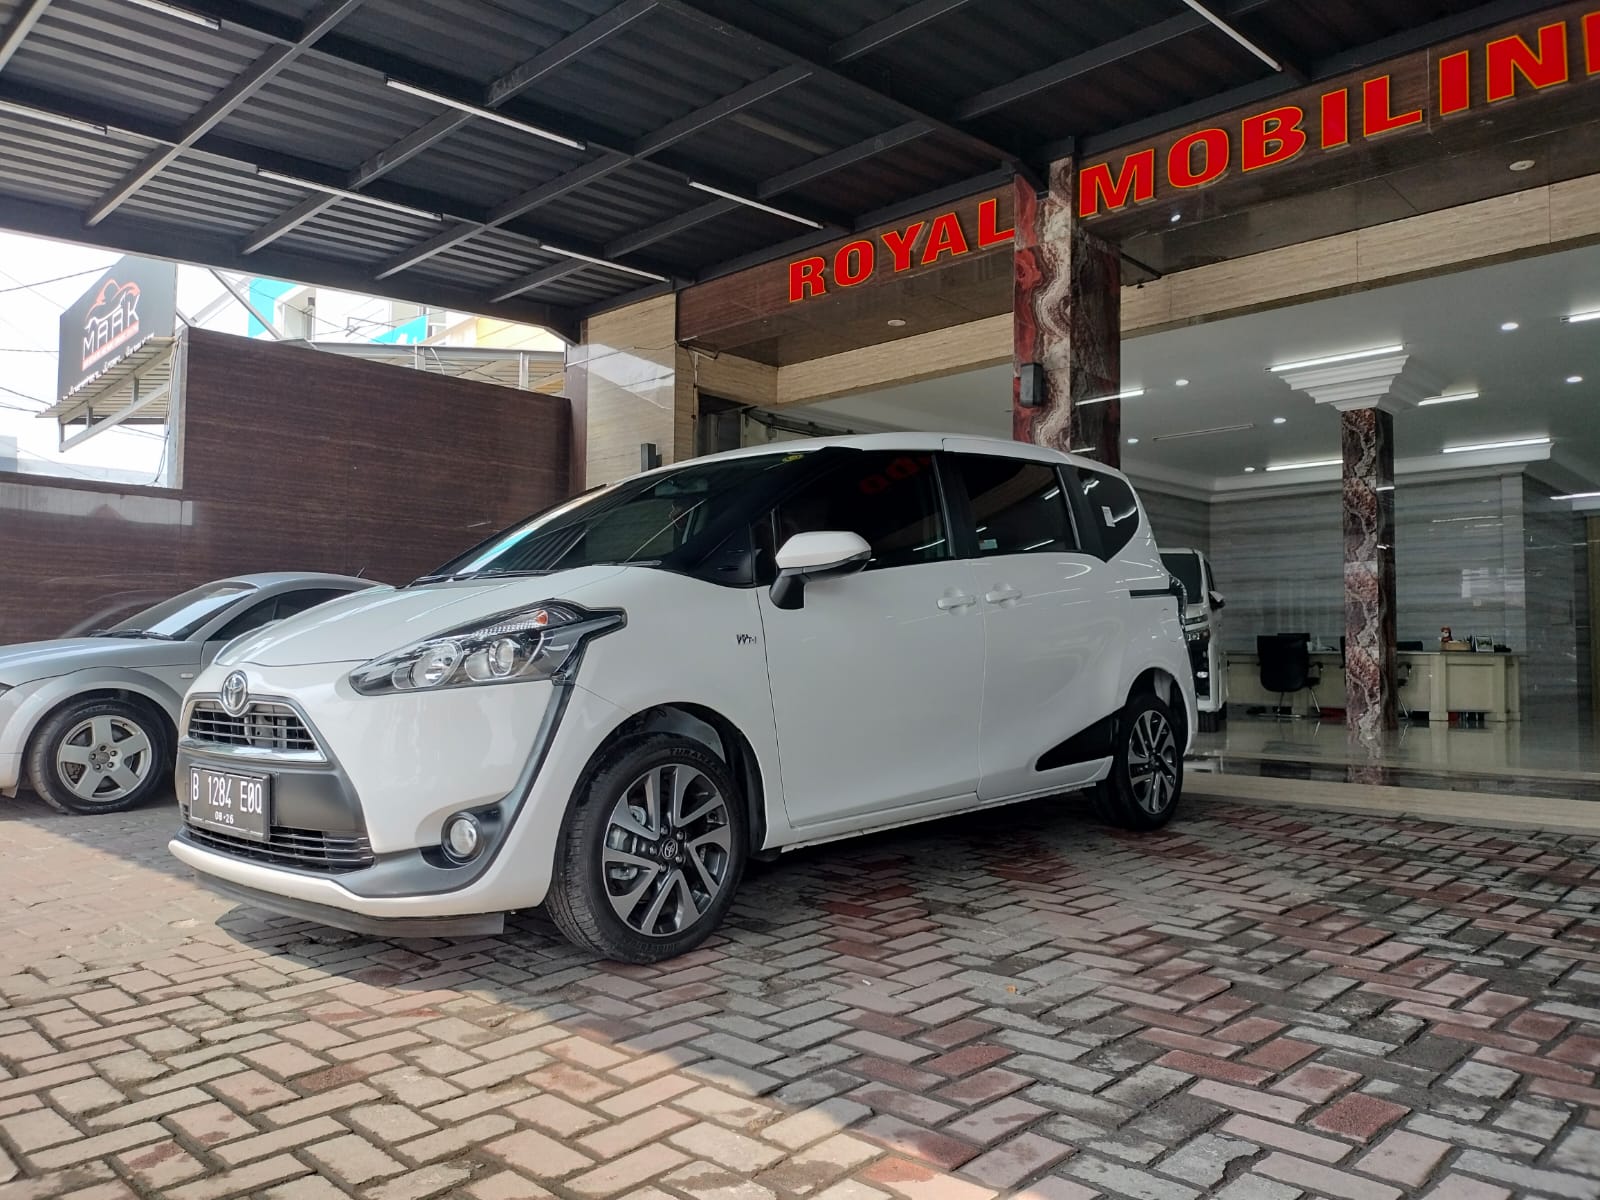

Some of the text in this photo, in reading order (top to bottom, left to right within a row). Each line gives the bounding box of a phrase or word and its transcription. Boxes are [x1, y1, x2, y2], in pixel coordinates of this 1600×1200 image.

[788, 198, 1015, 303] ROYAL
[192, 772, 200, 801] B
[207, 775, 232, 809] 1284
